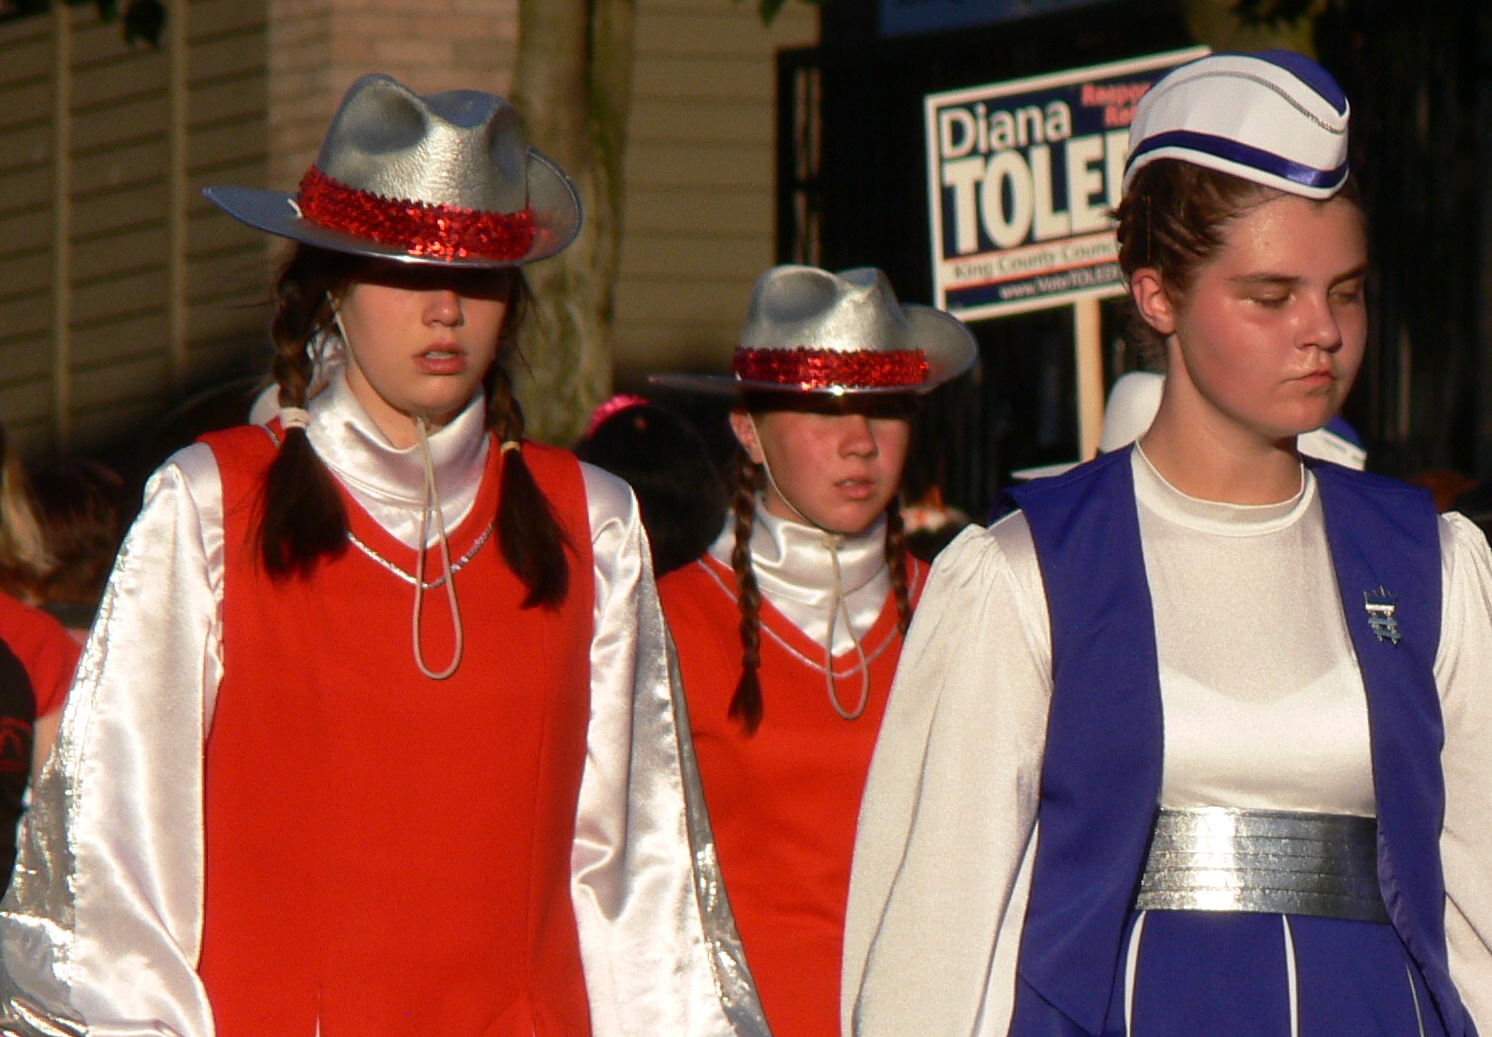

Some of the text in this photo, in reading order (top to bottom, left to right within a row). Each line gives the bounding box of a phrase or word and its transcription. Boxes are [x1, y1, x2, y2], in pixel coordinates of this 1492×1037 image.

[942, 101, 1072, 159] Diana
[954, 261, 993, 282] King
[999, 248, 1055, 272] County
